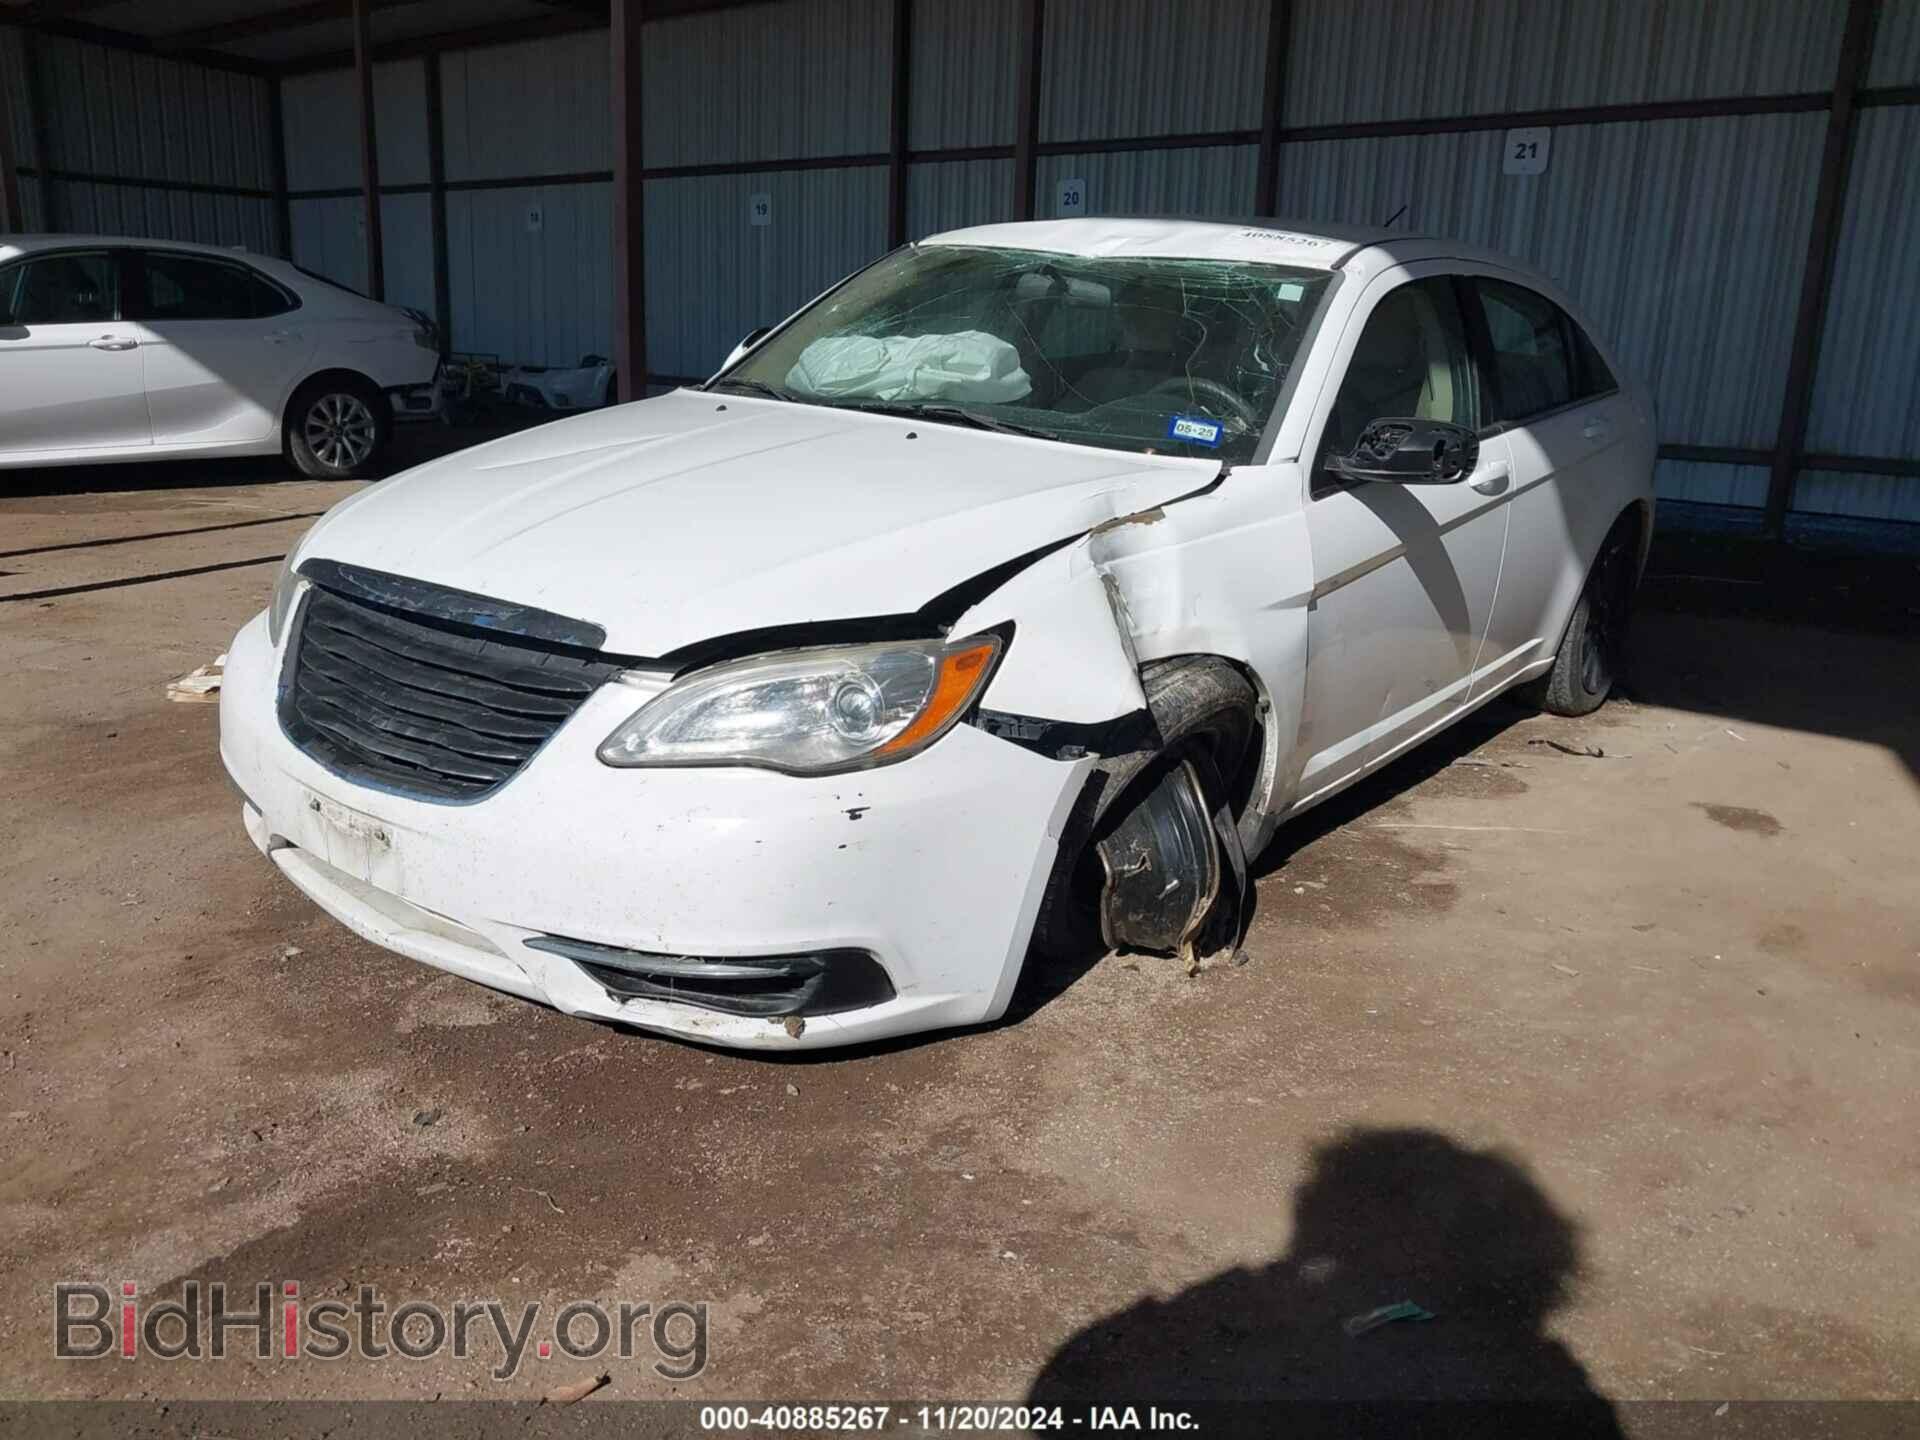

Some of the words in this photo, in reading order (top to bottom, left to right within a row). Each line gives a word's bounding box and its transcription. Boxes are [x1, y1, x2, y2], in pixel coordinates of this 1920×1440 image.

[1514, 143, 1537, 159] 21
[1063, 191, 1079, 206] 20
[755, 203, 768, 216] 19
